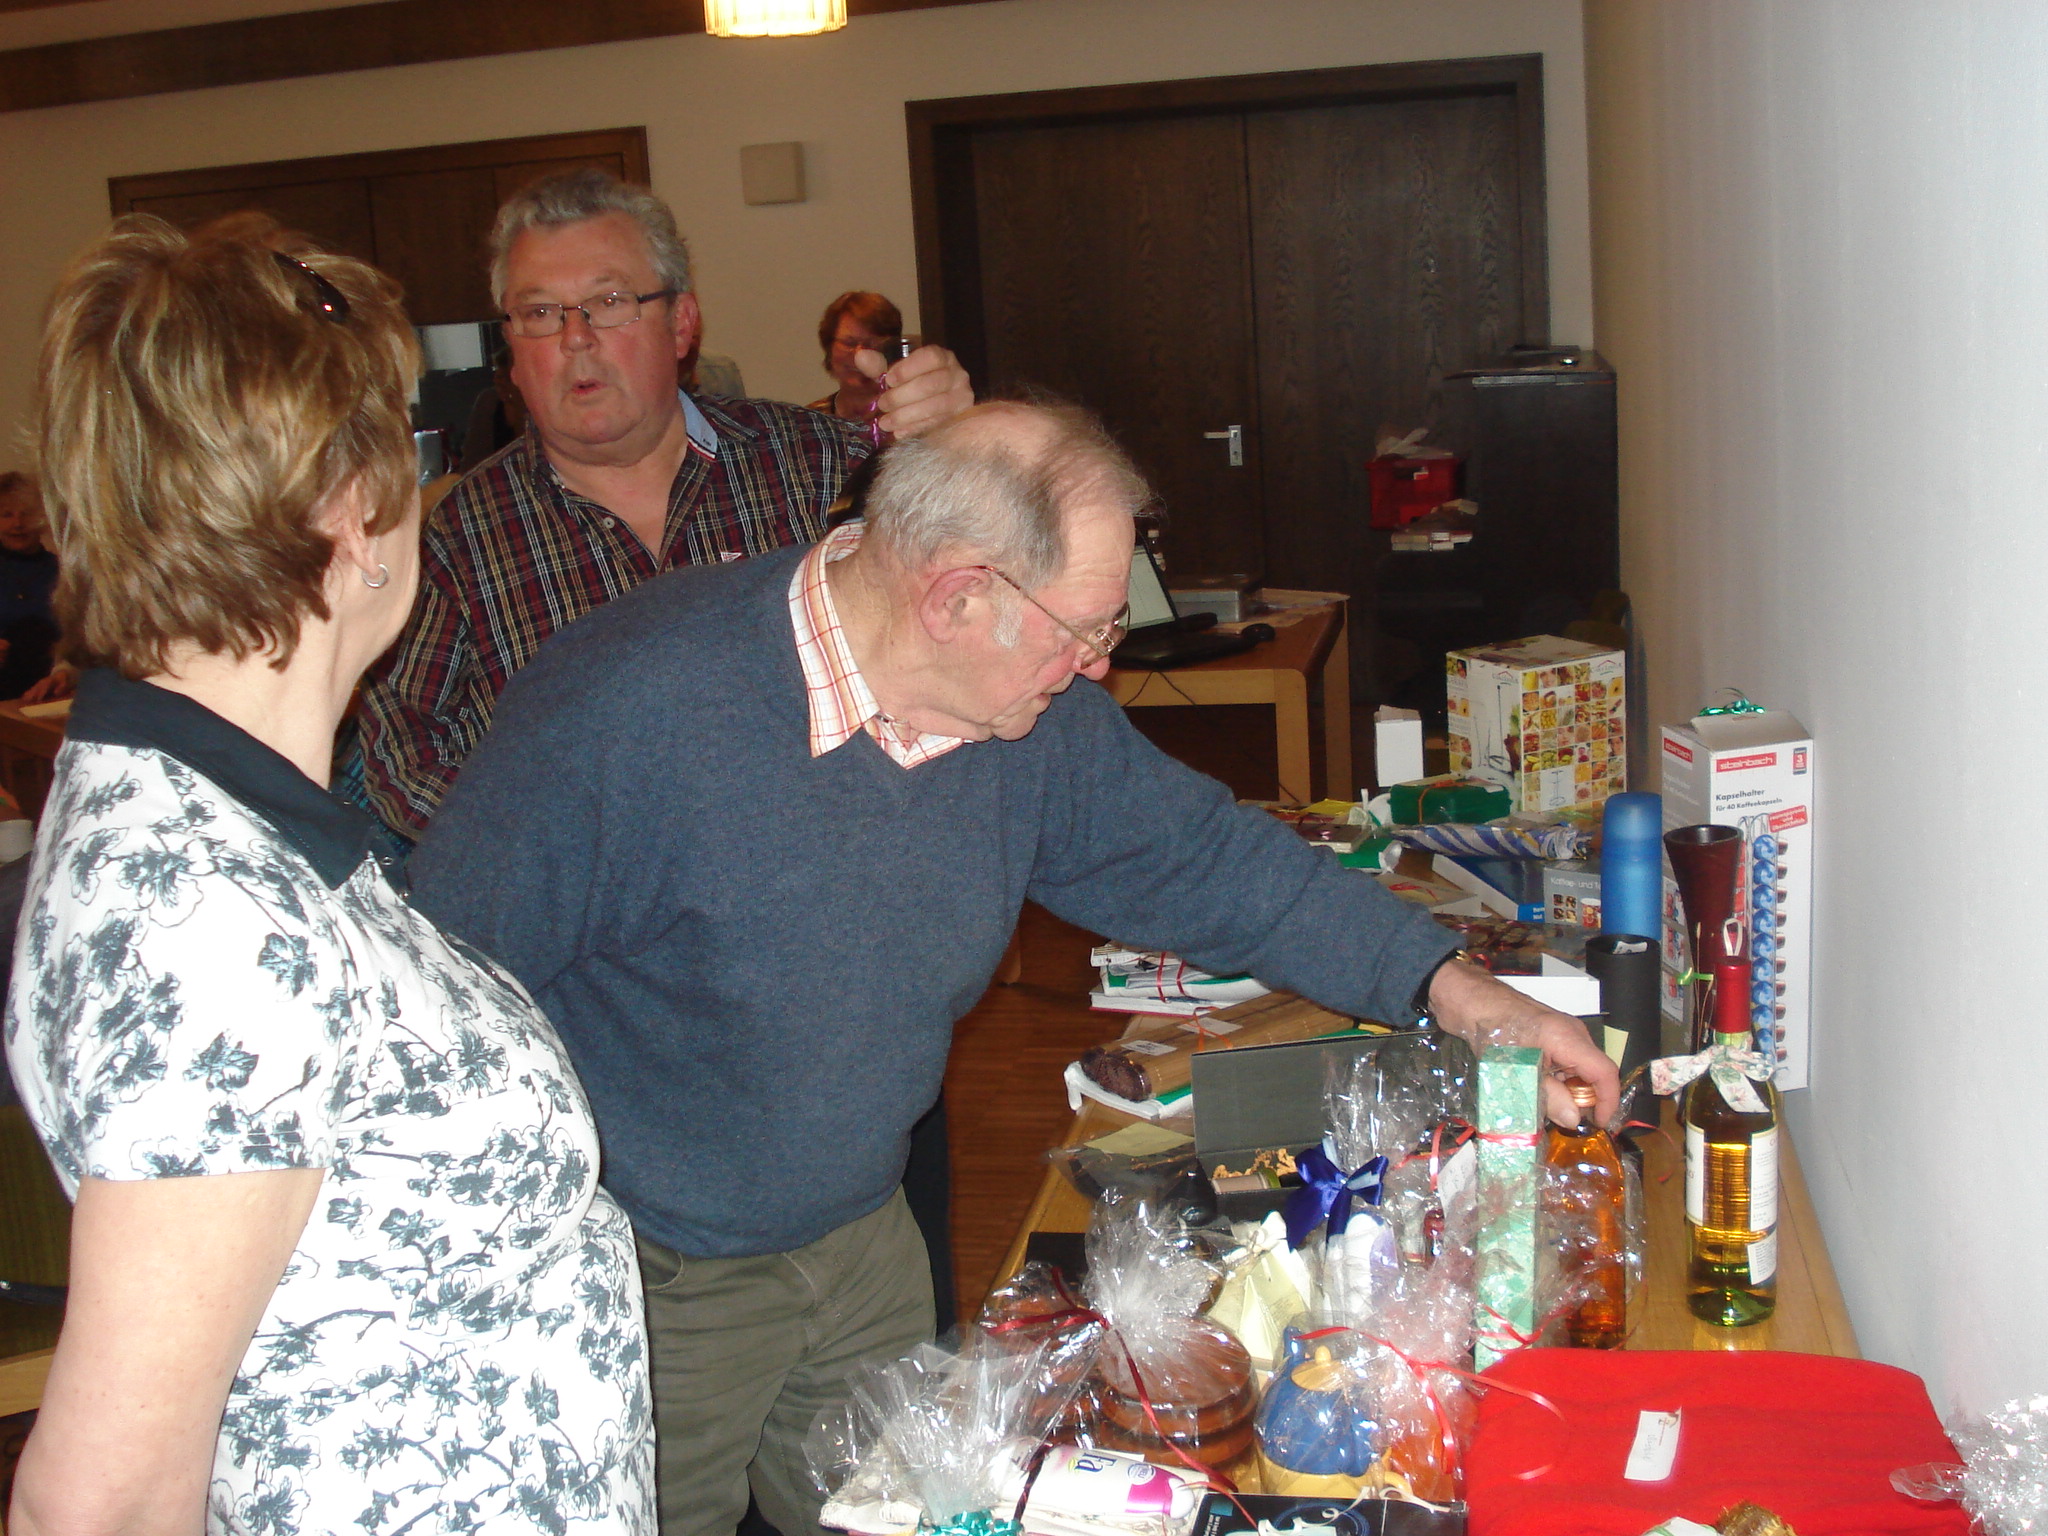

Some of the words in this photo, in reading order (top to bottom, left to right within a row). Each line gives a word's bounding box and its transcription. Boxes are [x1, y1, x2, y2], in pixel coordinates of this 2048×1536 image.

[1719, 756, 1774, 770] steinbach
[1797, 754, 1803, 763] 3
[1715, 789, 1765, 802] Kapselhalter
[1715, 804, 1726, 812] für
[1736, 797, 1783, 809] Kaffeekapseln
[1578, 881, 1593, 889] und
[1073, 1452, 1118, 1473] Fa
